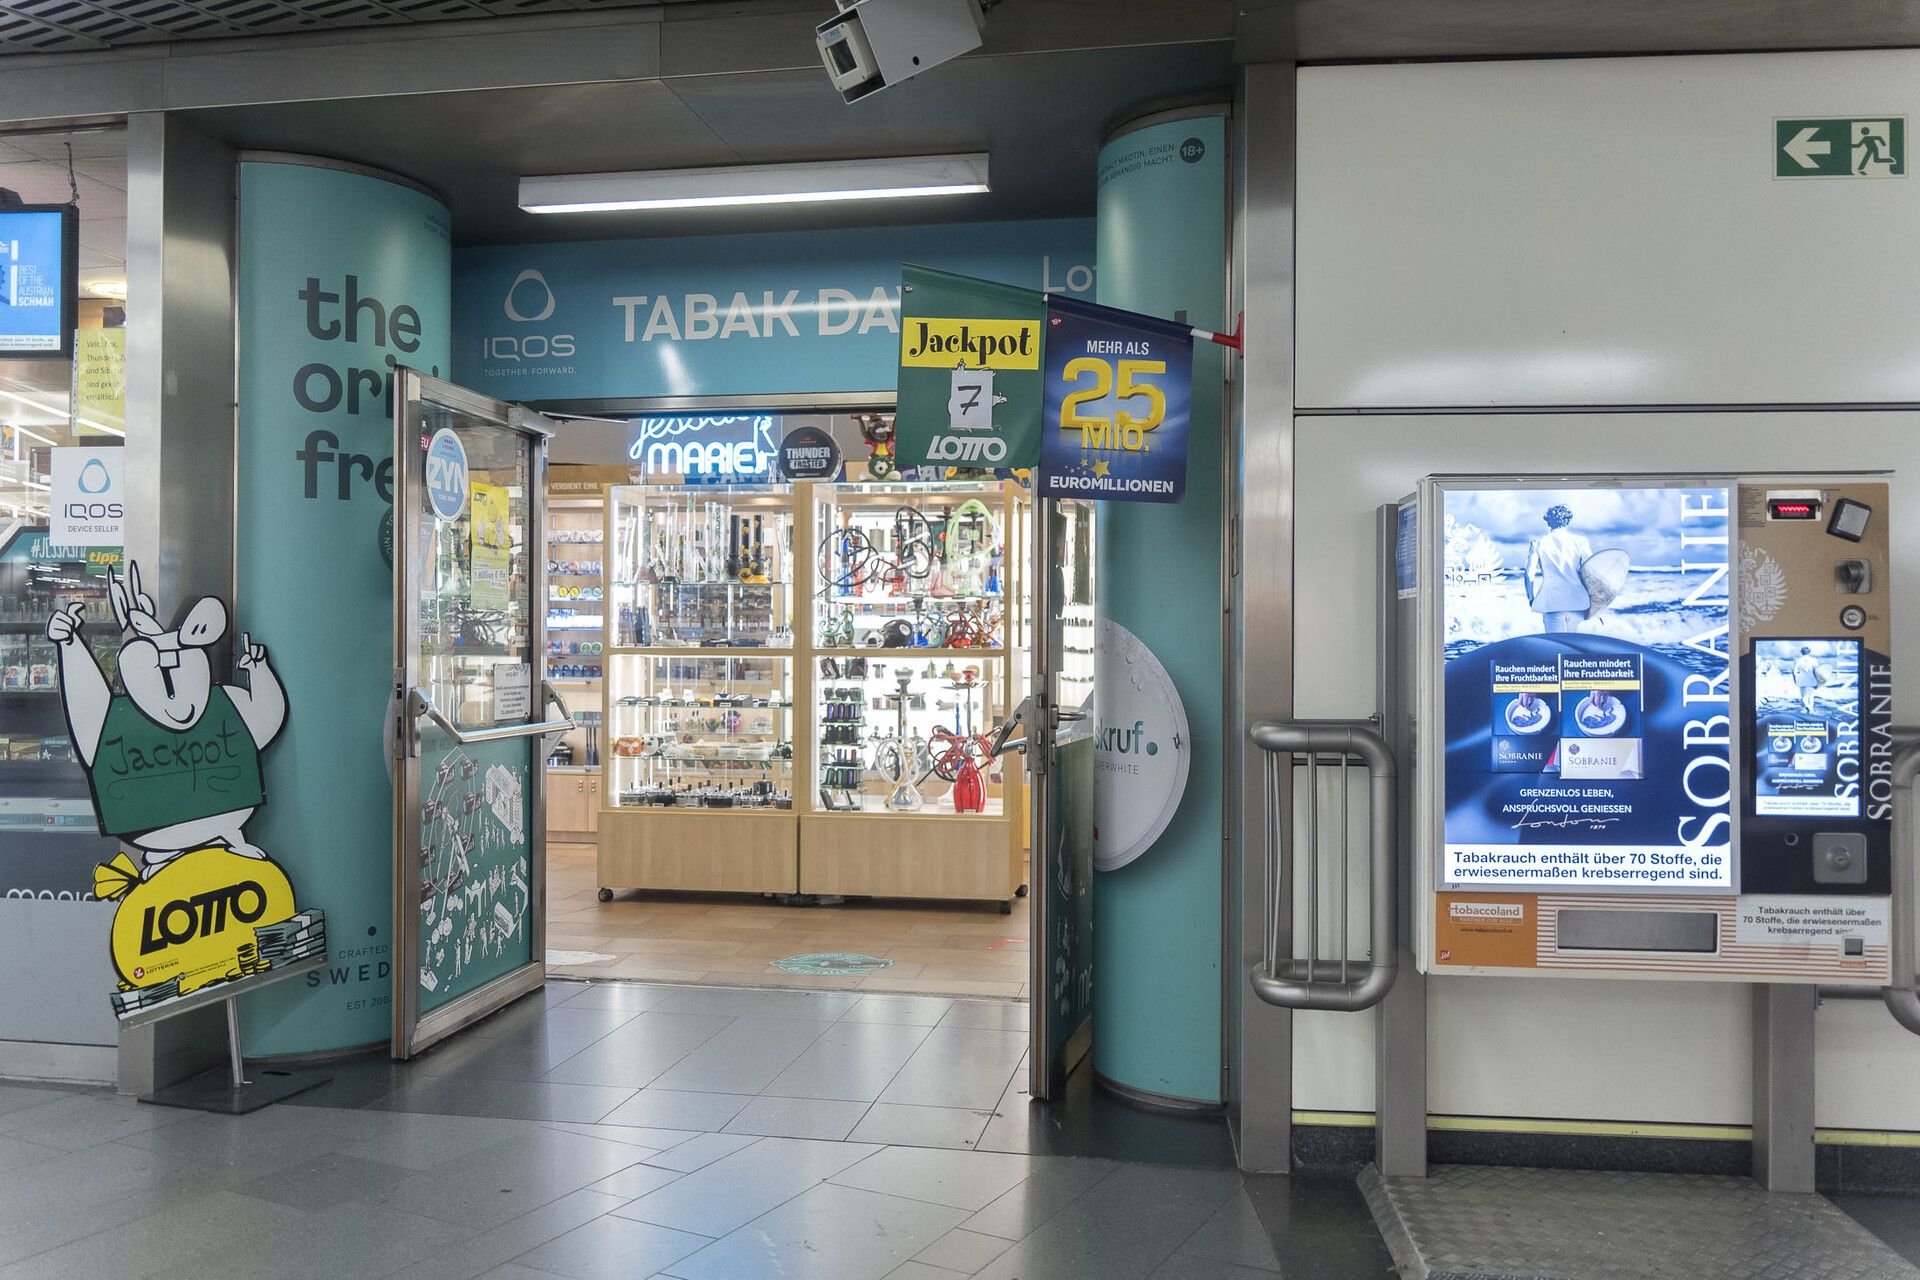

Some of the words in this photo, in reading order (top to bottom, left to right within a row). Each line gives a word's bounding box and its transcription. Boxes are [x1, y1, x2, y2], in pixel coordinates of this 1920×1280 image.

[1149, 143, 1175, 155] EINEN
[1181, 145, 1204, 158] 18+
[19, 286, 54, 295] AUSTRIAN
[297, 274, 422, 353] the
[612, 290, 802, 342] TABAK
[818, 285, 900, 337] DA
[483, 334, 577, 361] IQOS
[909, 321, 1033, 366] Jackpot
[1086, 340, 1122, 354] MEHR
[1126, 341, 1149, 355] ALS
[957, 385, 982, 415] 7
[1060, 357, 1167, 433] 25
[1081, 421, 1150, 452] MIO.
[785, 447, 831, 459] THUNDER
[926, 435, 1007, 462] LOTTO
[647, 441, 754, 474] MARIE
[427, 456, 466, 494] ZYN
[1049, 475, 1174, 494] EUROMILLIONEN
[64, 503, 124, 521] IQOS
[1495, 665, 1526, 673] Rauchen
[1527, 664, 1556, 673] mindert
[1563, 660, 1597, 668] Rauchen
[1599, 659, 1631, 668] mindert
[1678, 494, 1729, 848] SOBRANIE
[1495, 674, 1510, 682] Ihre
[1510, 674, 1558, 682] Fruchtbarkeit
[1563, 670, 1580, 678] Ihre
[1581, 669, 1634, 678] Fruchtbarkeit
[1867, 664, 1892, 820] SOBRANIE
[106, 719, 239, 792] Jackpot
[1499, 752, 1543, 760] SOBRANIE
[1568, 757, 1618, 766] SOBRANIE
[1519, 788, 1580, 797] GRENZENLOS
[1582, 789, 1614, 799] LEBEN,
[1502, 804, 1579, 813] ANSPRUCHSVOLL
[1581, 804, 1632, 813] GENIESSEN
[1454, 851, 1536, 864] Tabakrauch
[1540, 852, 1589, 864] enthält
[1594, 853, 1625, 865] über
[1630, 853, 1646, 865] 70
[1651, 853, 1697, 866] Stoffe,
[1701, 854, 1722, 866] die
[1454, 865, 1577, 879] erwiesenermaßen
[1582, 867, 1684, 881] krebserregend
[1689, 868, 1722, 880] sind.
[1453, 904, 1520, 916] tobaccoland
[1758, 906, 1810, 915] Tabakrauch
[1813, 907, 1843, 916] enthält
[1846, 908, 1866, 916] über
[140, 880, 267, 956] LOTTO
[1743, 915, 1753, 923] 70
[1755, 916, 1785, 925] Stoffe,
[1787, 917, 1800, 925] die
[1803, 917, 1882, 926] erwiesenermaßen
[1768, 926, 1832, 936] krebserregend
[339, 944, 388, 959] CRAFTED
[146, 961, 179, 975] LOTTERIEN
[346, 1000, 367, 1011] EST
